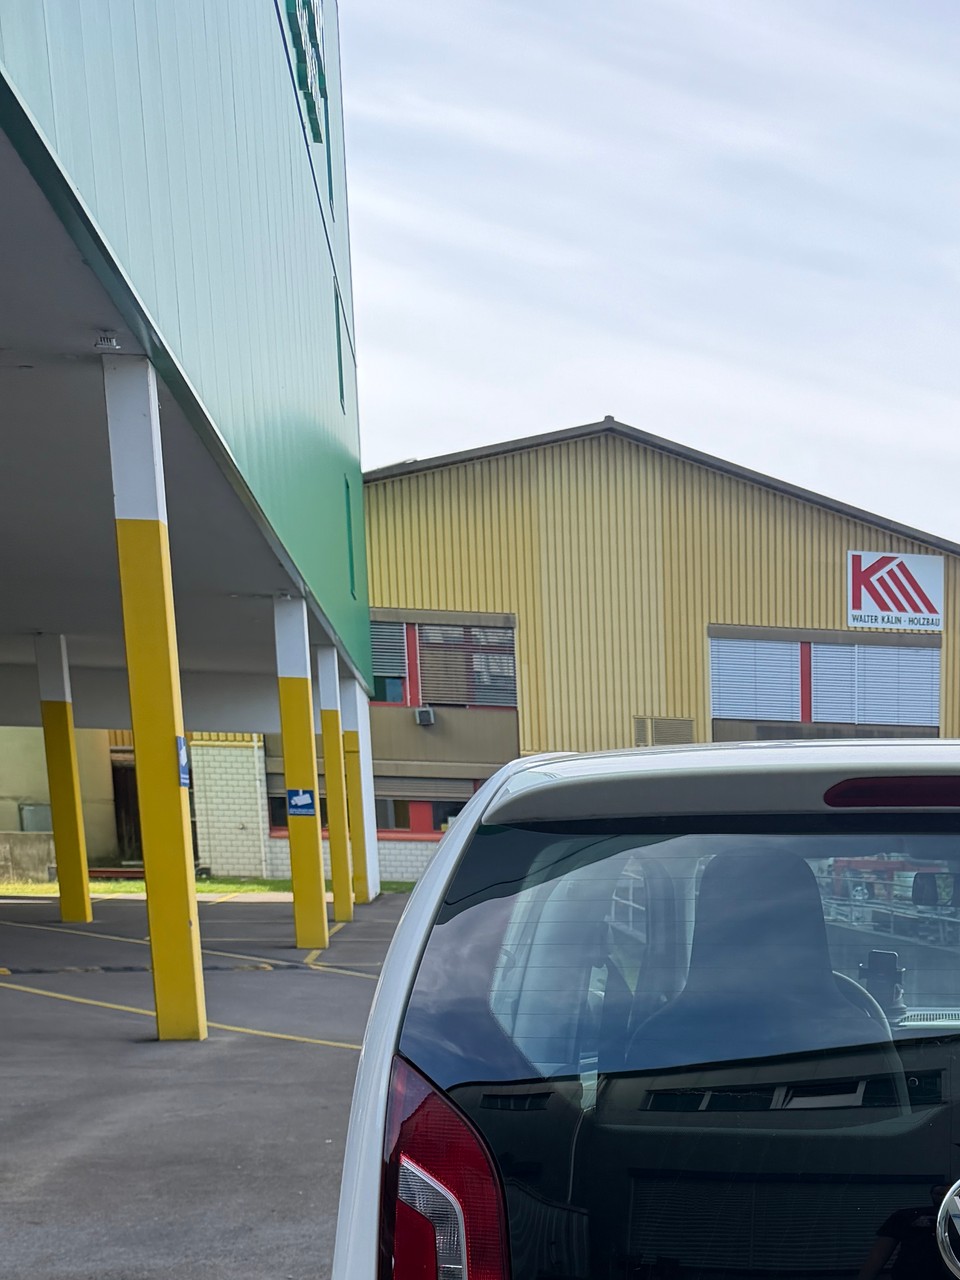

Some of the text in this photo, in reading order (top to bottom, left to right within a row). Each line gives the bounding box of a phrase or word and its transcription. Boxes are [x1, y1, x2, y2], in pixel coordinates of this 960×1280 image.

[852, 614, 878, 624] WALTER
[881, 614, 902, 625] KÄLIN
[908, 617, 940, 627] HOLZBAU
